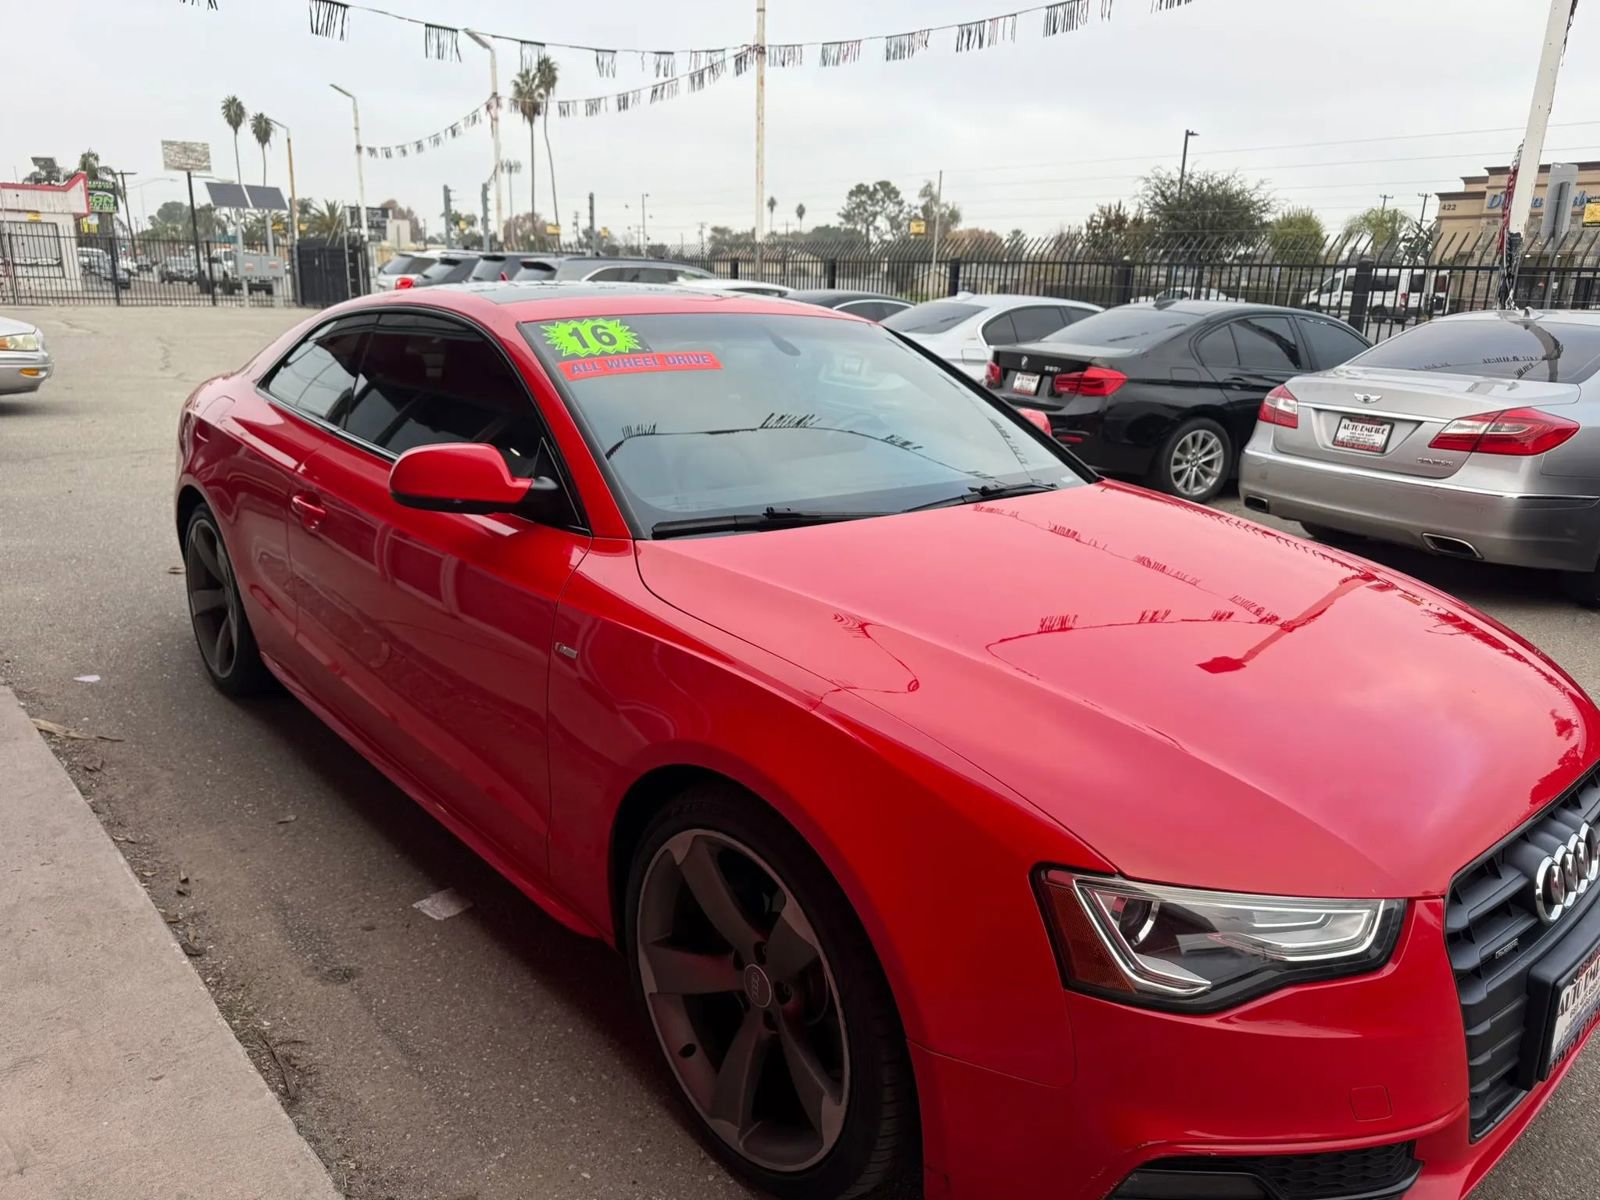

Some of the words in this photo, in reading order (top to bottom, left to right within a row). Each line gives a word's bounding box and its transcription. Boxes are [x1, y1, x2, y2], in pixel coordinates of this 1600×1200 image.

[1441, 203, 1457, 211] 422
[568, 324, 618, 349] 16
[572, 362, 602, 374] ALL
[607, 358, 660, 369] WHEEL
[666, 354, 711, 365] DRIVE
[1342, 423, 1359, 431] AUTO
[1558, 982, 1580, 1017] AUTO
